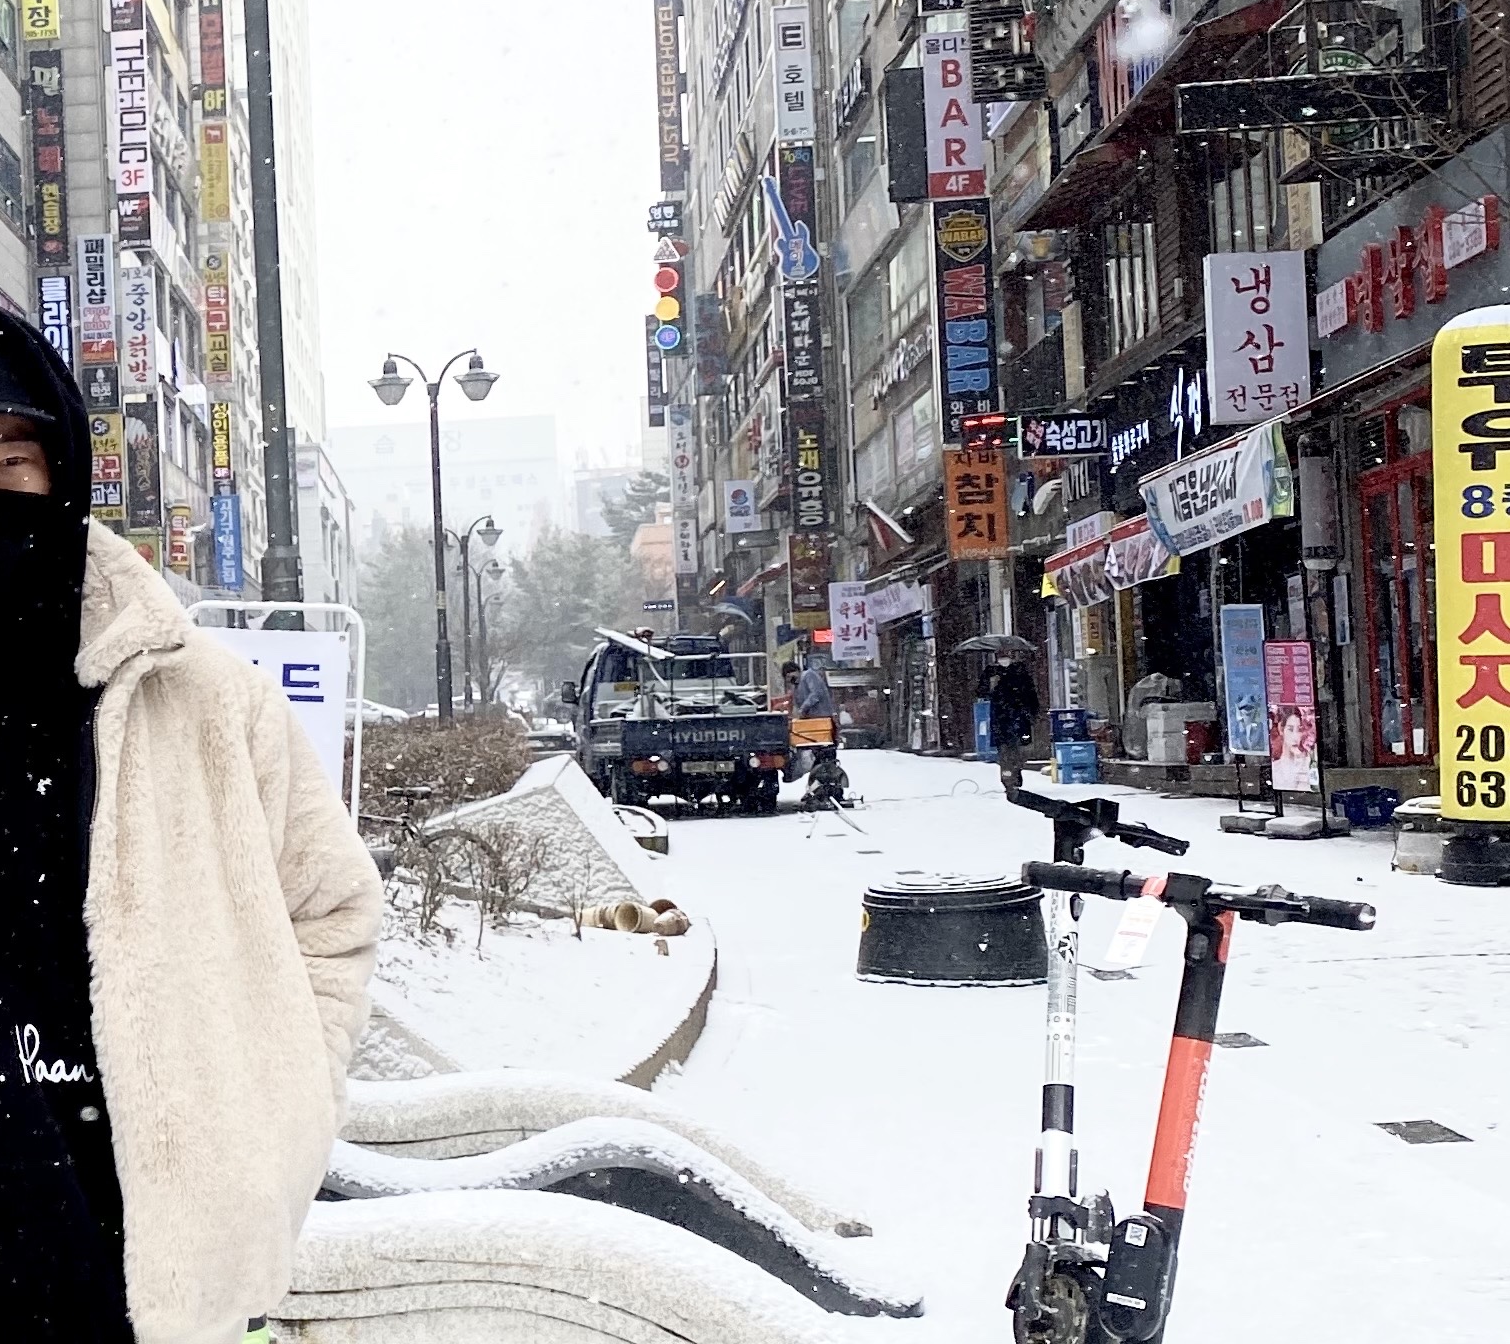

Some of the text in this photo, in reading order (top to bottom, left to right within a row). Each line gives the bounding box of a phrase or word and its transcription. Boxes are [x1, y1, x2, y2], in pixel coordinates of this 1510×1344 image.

[782, 65, 804, 112] 호텔
[940, 59, 968, 167] BAR
[121, 169, 145, 186] 3F
[945, 175, 970, 192] 4F
[943, 264, 990, 394] WABAR
[1231, 264, 1284, 374] 냉삼
[1227, 382, 1299, 412] 전문점
[1046, 419, 1108, 451] 숙성고기
